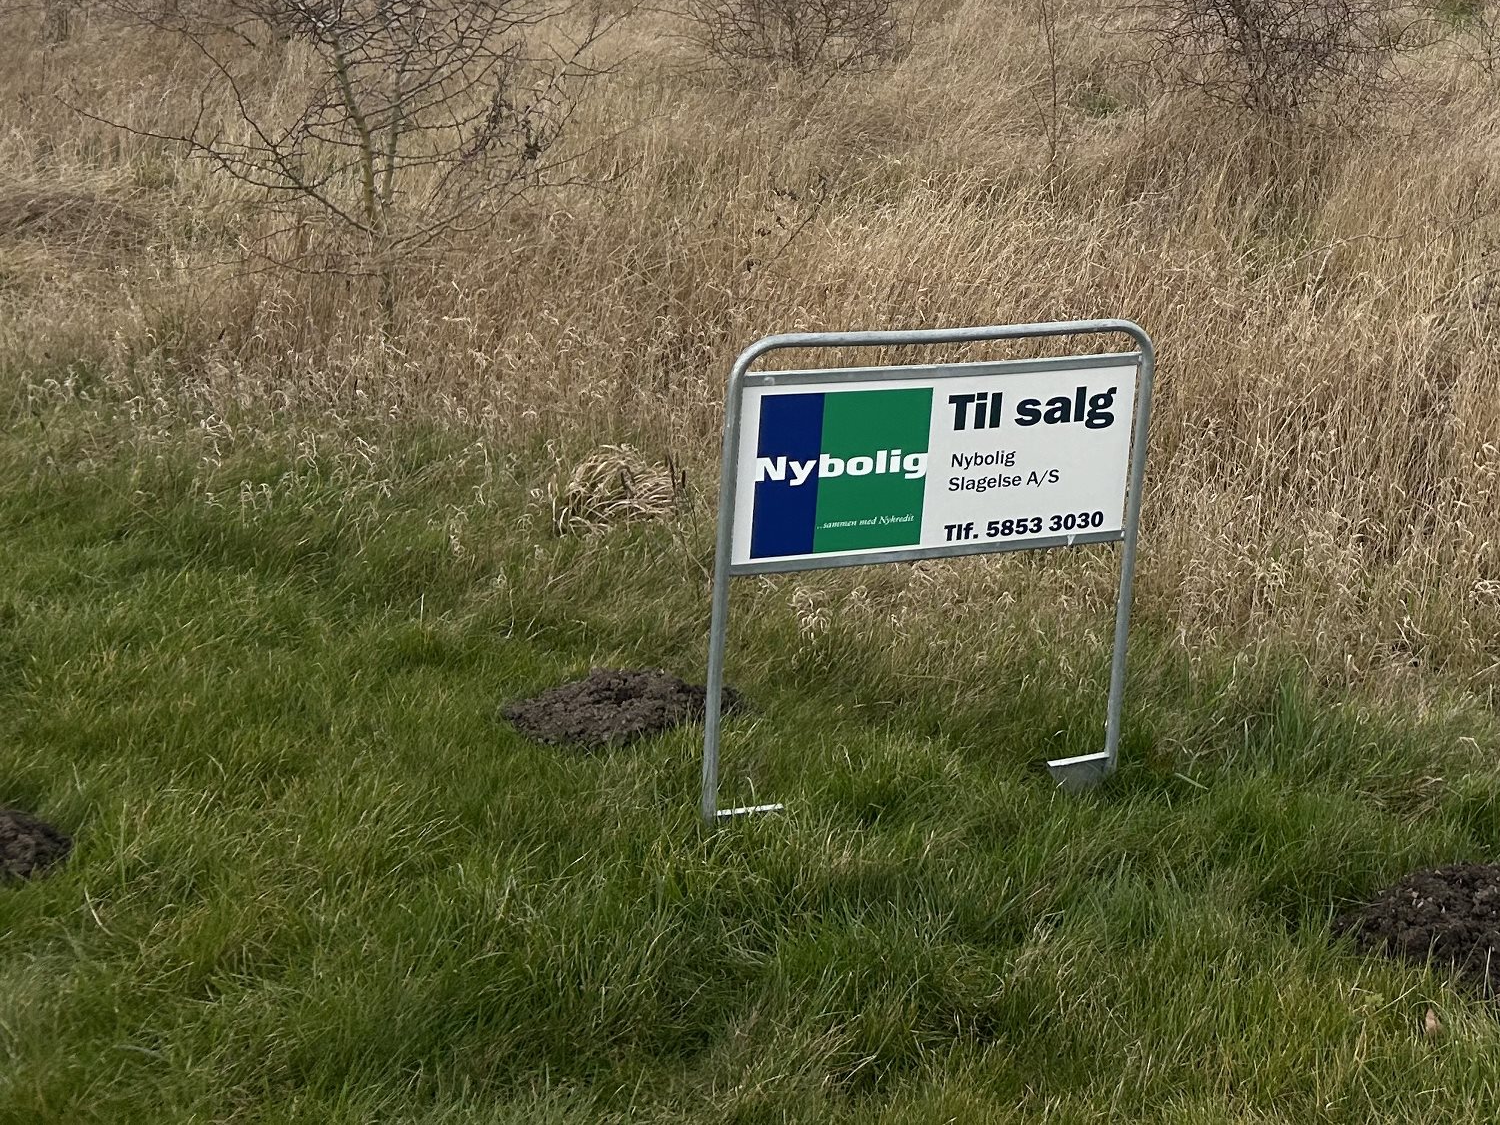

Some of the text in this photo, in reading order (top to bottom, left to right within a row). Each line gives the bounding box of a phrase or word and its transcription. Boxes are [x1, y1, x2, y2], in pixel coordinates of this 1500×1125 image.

[948, 386, 1118, 431] Til salg
[755, 449, 928, 486] Nybolig
[951, 450, 1016, 470] Nybolig
[948, 469, 1060, 493] Slagelse A/S
[859, 516, 878, 526] med
[986, 517, 1043, 538] 5853
[1048, 511, 1104, 531] 3030
